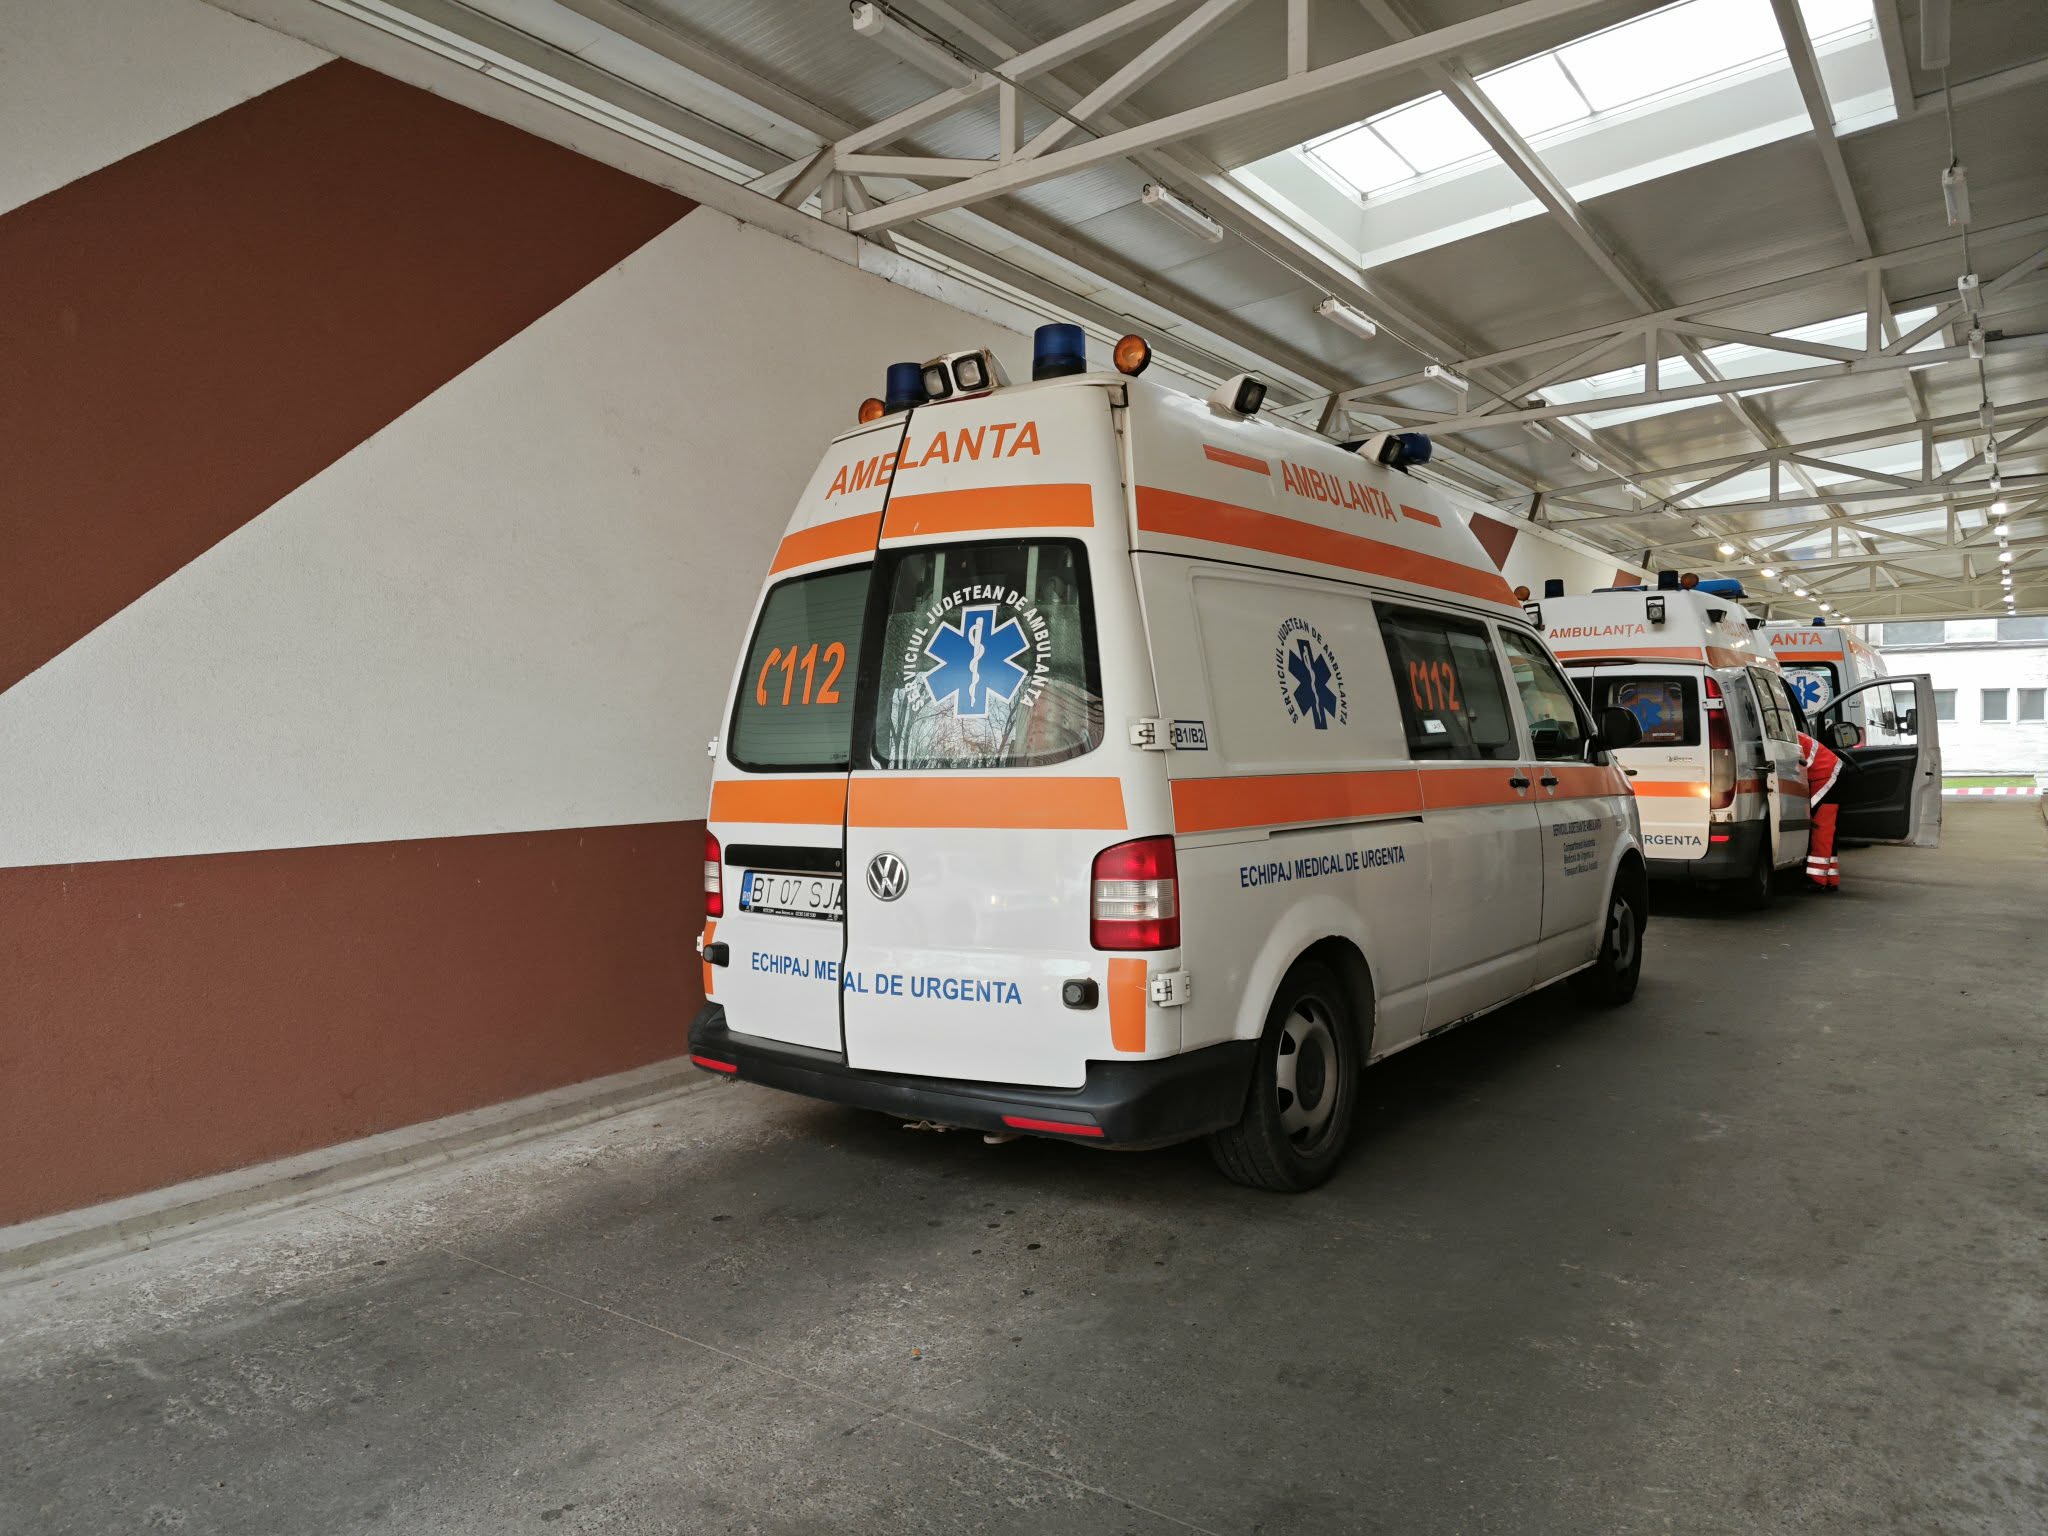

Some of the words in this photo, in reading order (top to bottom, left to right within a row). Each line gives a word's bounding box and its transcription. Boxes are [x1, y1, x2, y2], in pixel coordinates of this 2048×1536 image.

[825, 421, 1041, 500] AMBLANTA
[1281, 459, 1398, 522] AMBULANTA
[903, 627, 929, 711] SERVICIUL
[926, 585, 1006, 625] JUDETEAN
[1005, 590, 1029, 611] DE
[1020, 607, 1051, 707] AMBULANTA
[1277, 617, 1310, 646] JUDETEAN
[1311, 626, 1322, 645] DE
[780, 641, 846, 706] 112
[1275, 647, 1299, 724] SERVICIUL
[1323, 644, 1348, 726] AMBULANTA
[1419, 660, 1460, 711] 112
[1240, 861, 1292, 888] ECHIPAJ
[1294, 854, 1344, 880] MEDICAL
[1345, 851, 1360, 871] DE
[1361, 845, 1406, 869] URGENTA
[1644, 834, 1702, 846] RGENTA
[751, 877, 775, 904] BT
[780, 879, 802, 906] 07
[751, 951, 810, 978] ECHIPAJ
[875, 973, 903, 996] DE
[911, 975, 1023, 1005] URGENTA
